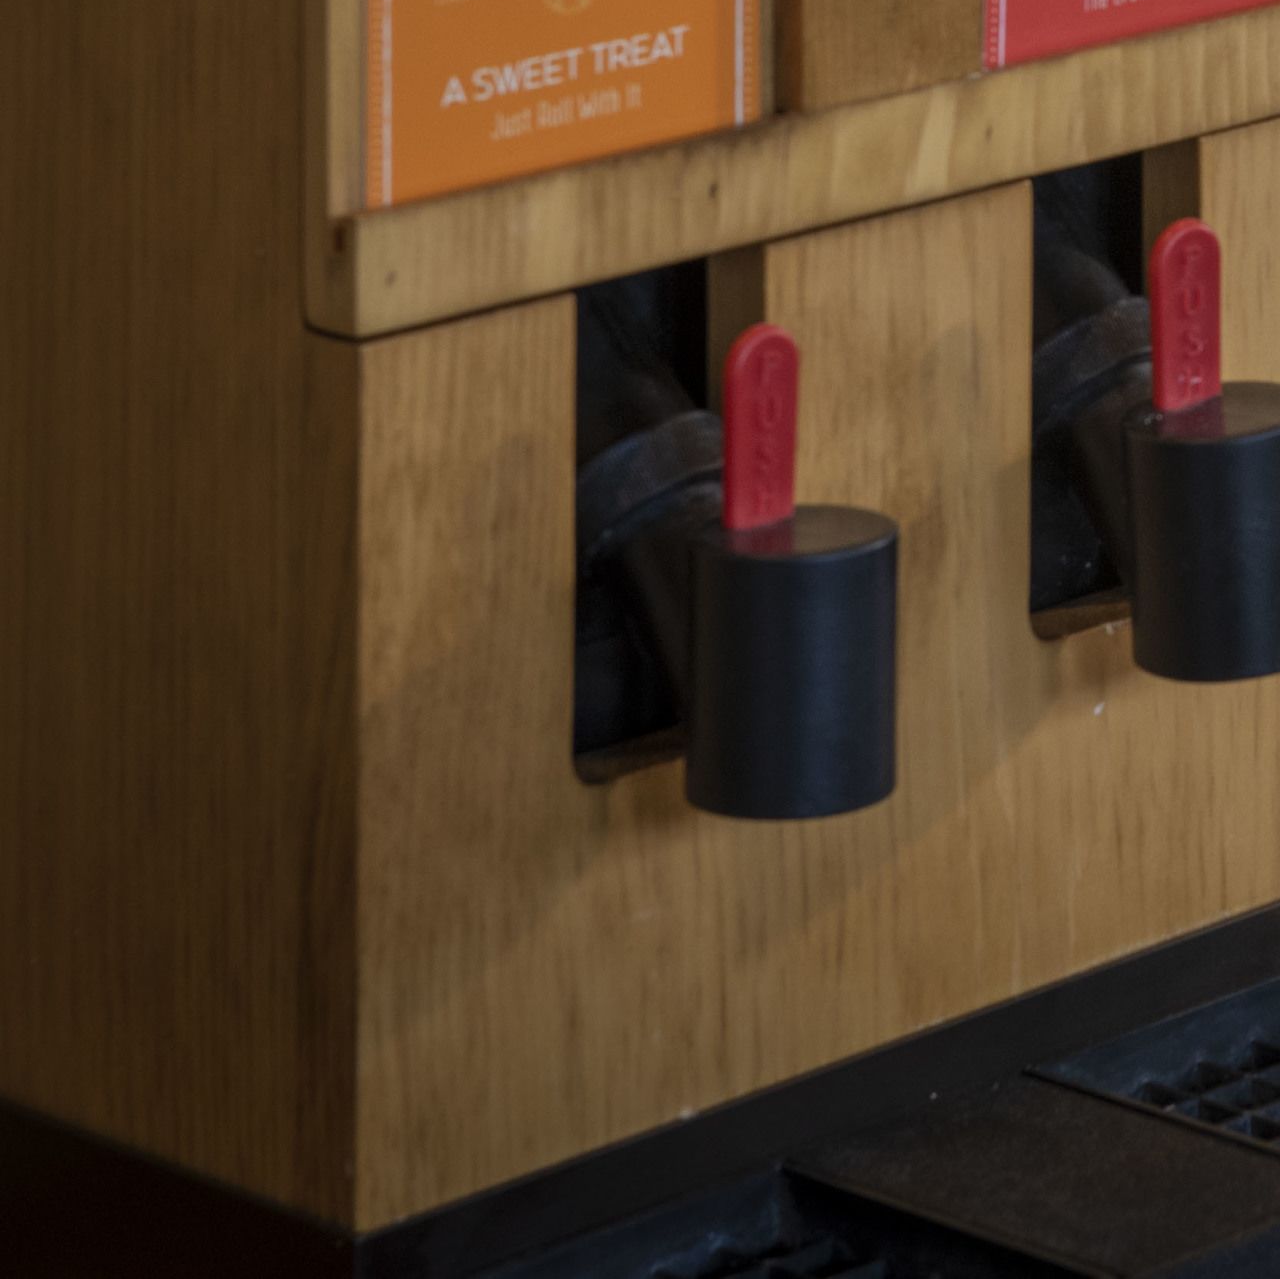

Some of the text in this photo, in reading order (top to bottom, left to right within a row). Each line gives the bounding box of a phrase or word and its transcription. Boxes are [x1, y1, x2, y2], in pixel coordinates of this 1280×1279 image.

[440, 24, 691, 108] A SWEET TREAT
